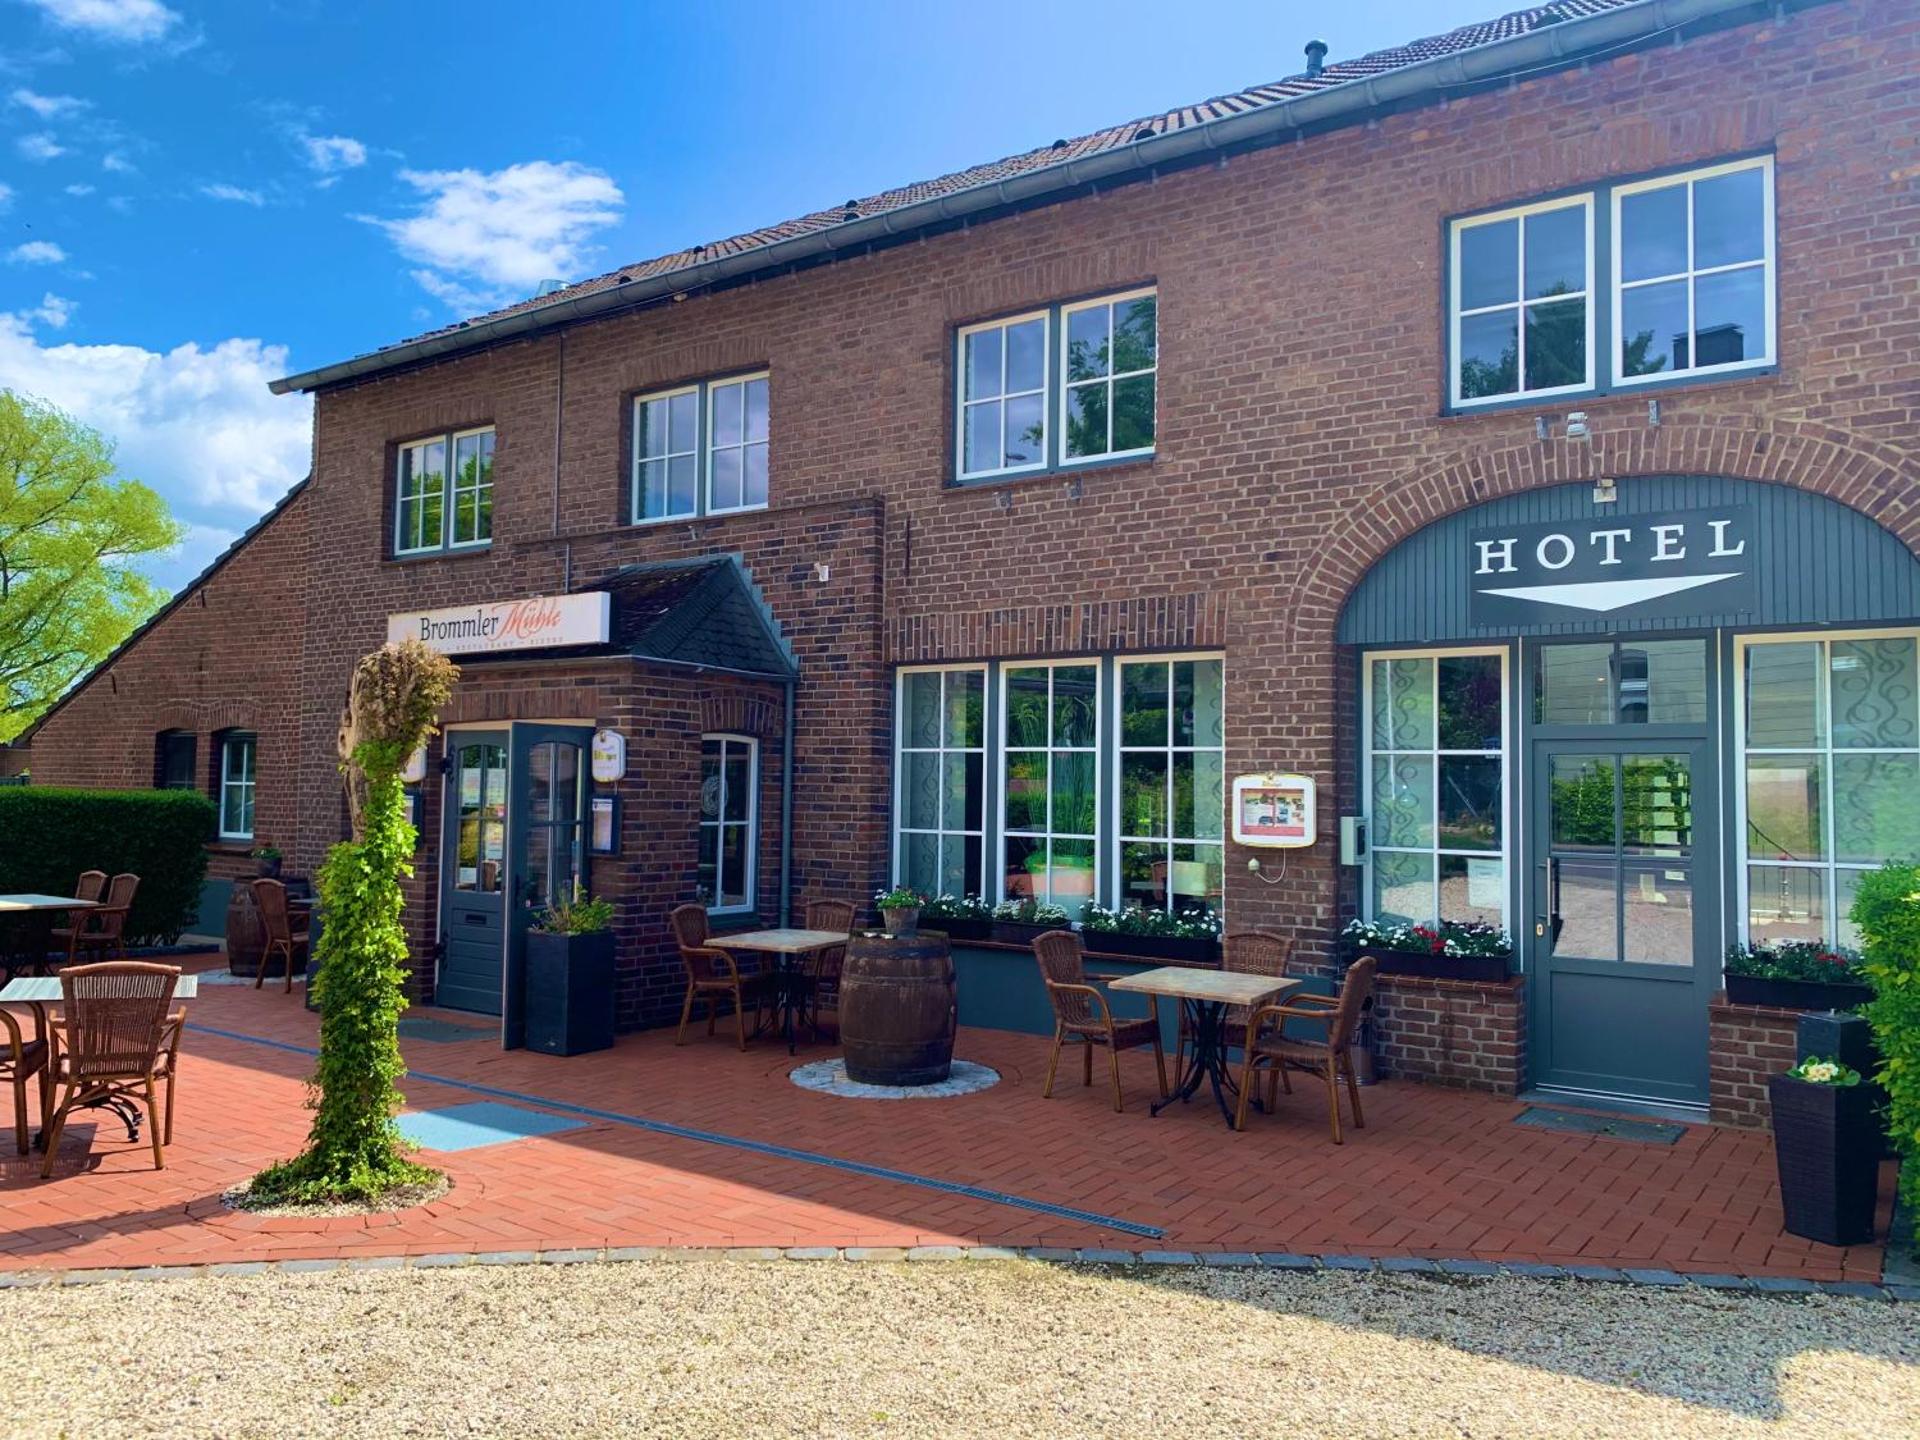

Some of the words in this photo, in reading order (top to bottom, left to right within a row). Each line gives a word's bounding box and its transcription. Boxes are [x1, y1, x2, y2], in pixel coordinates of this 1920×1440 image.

[1474, 520, 1746, 574] HOTEL
[420, 609, 499, 641] Brommler
[487, 599, 561, 641] Mühle
